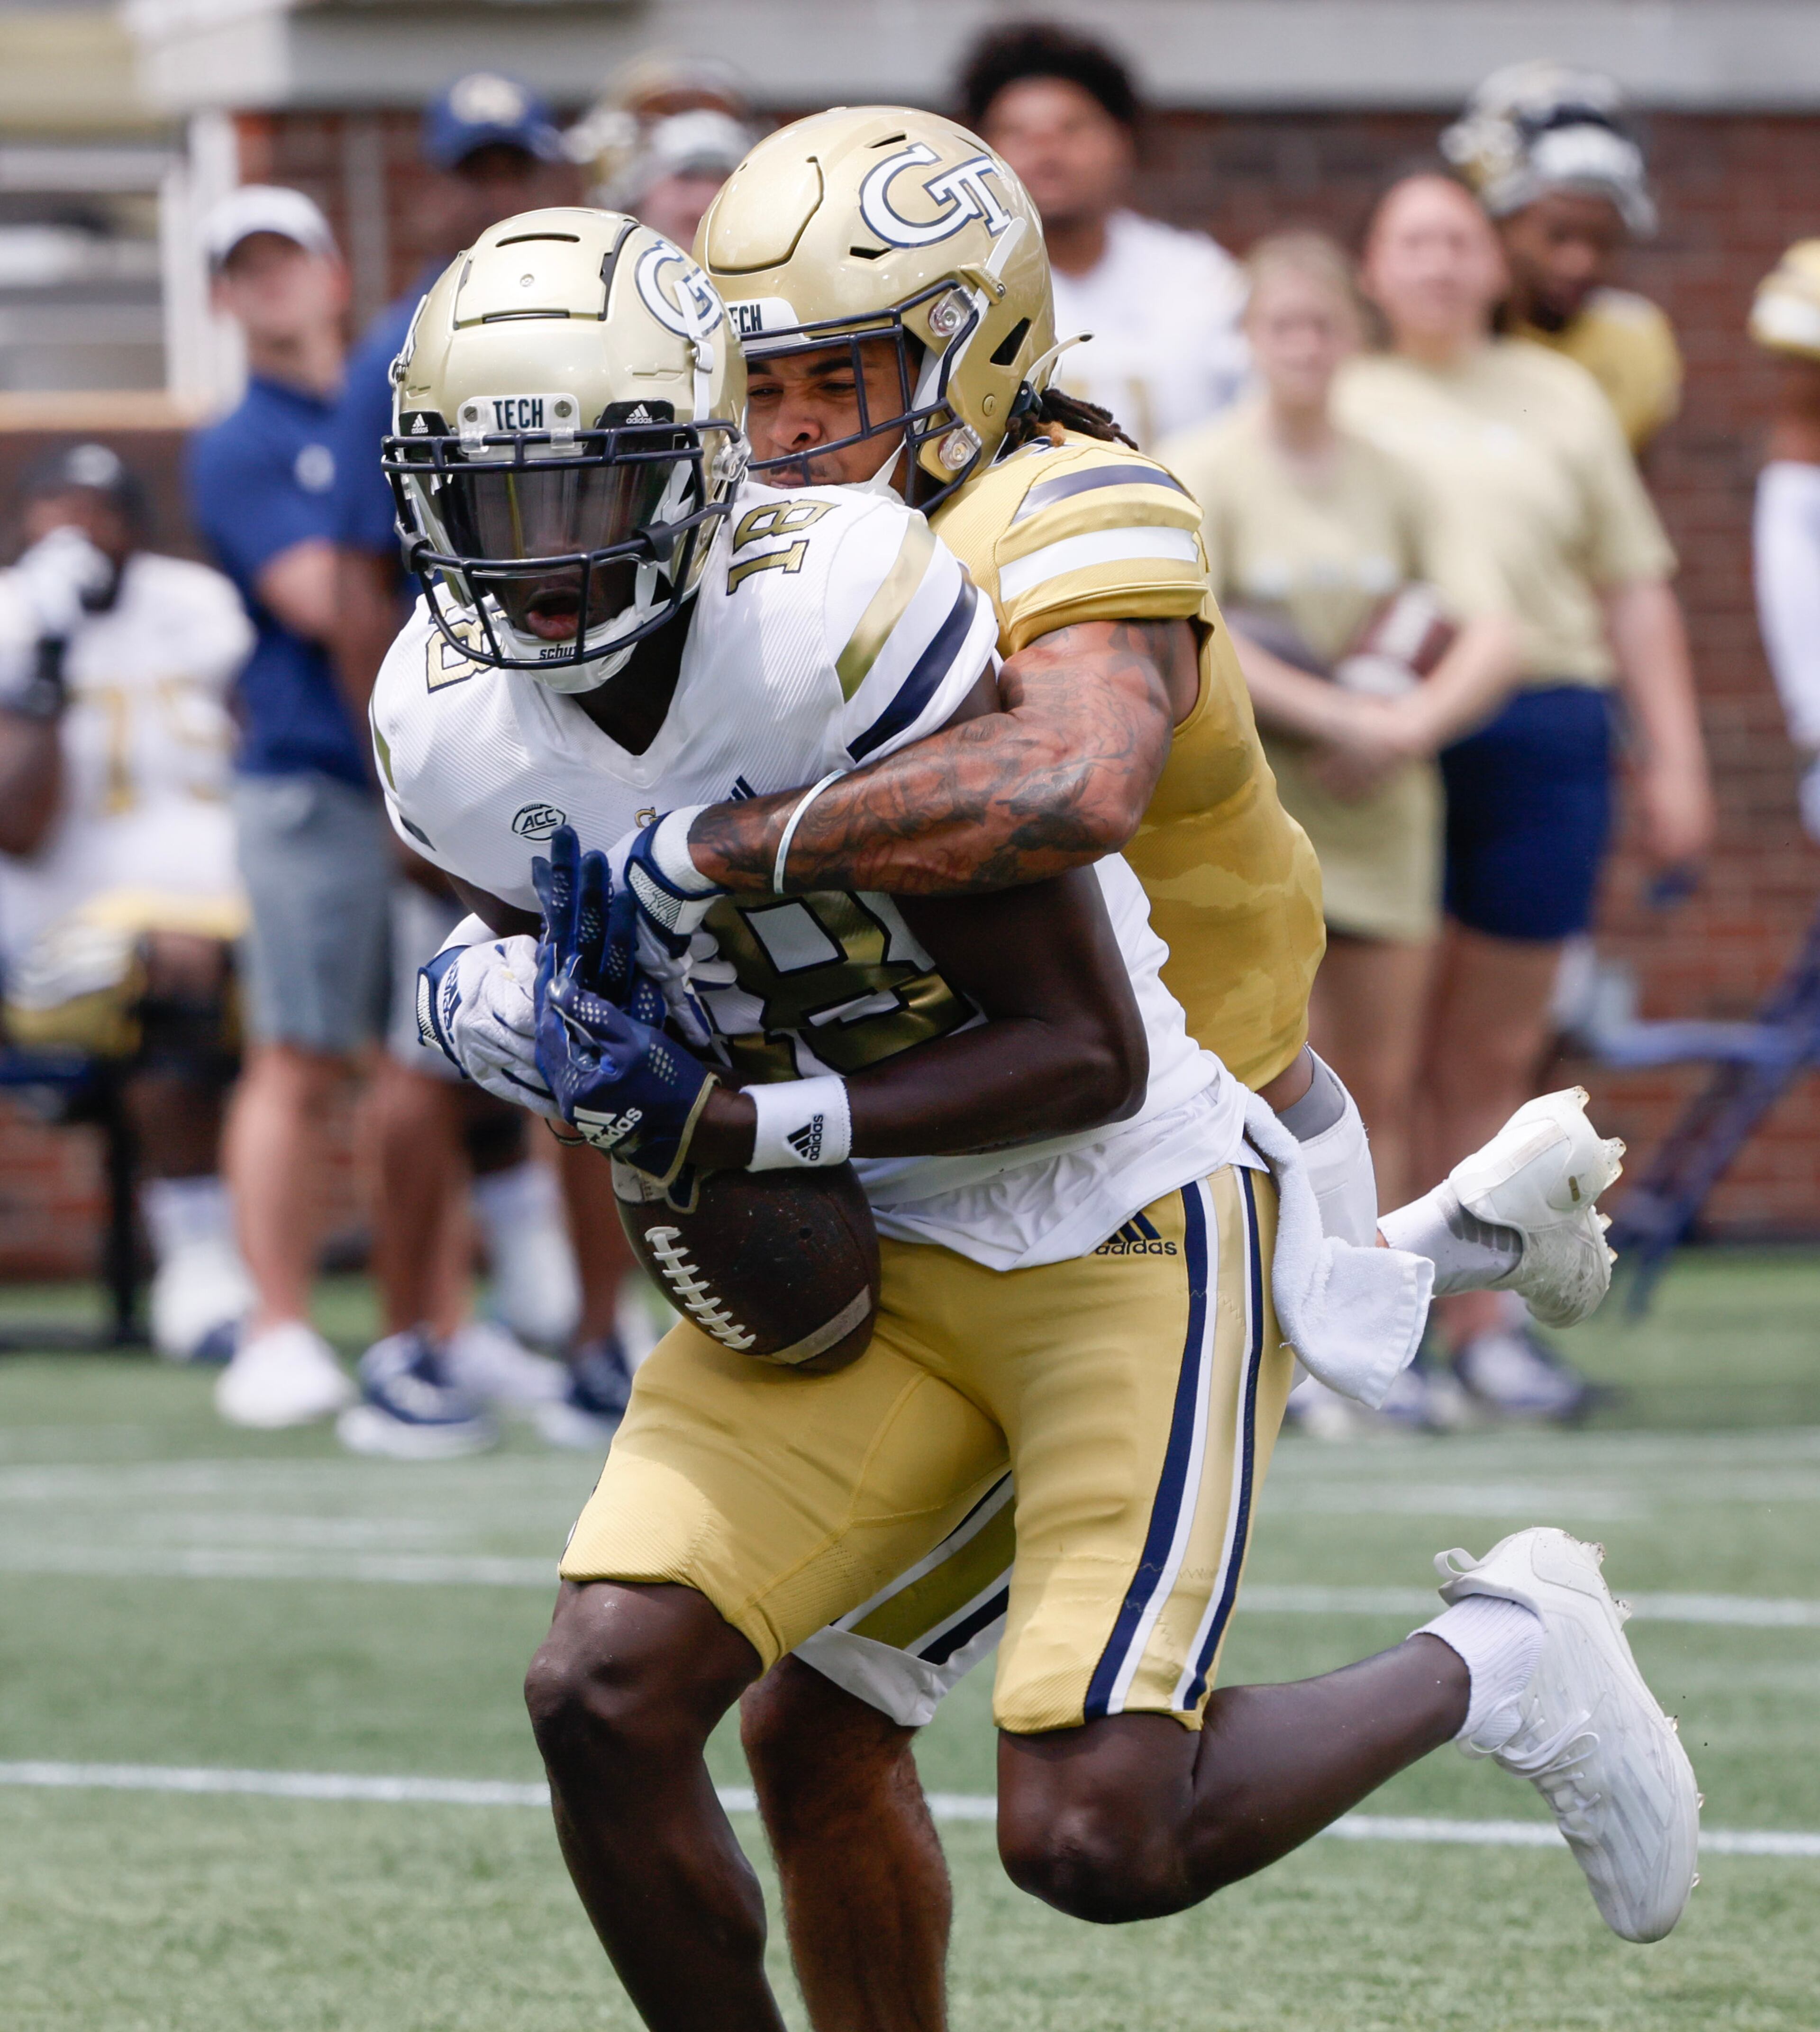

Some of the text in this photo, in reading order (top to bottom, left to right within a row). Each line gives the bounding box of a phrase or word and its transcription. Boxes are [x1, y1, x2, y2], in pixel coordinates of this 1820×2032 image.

[859, 141, 1013, 249] GT
[728, 304, 763, 333] ECH
[492, 399, 543, 430] TECH
[726, 499, 842, 596] 18
[522, 808, 557, 831] ACC
[809, 1114, 824, 1161] adidas
[1095, 1240, 1177, 1255] adidas
